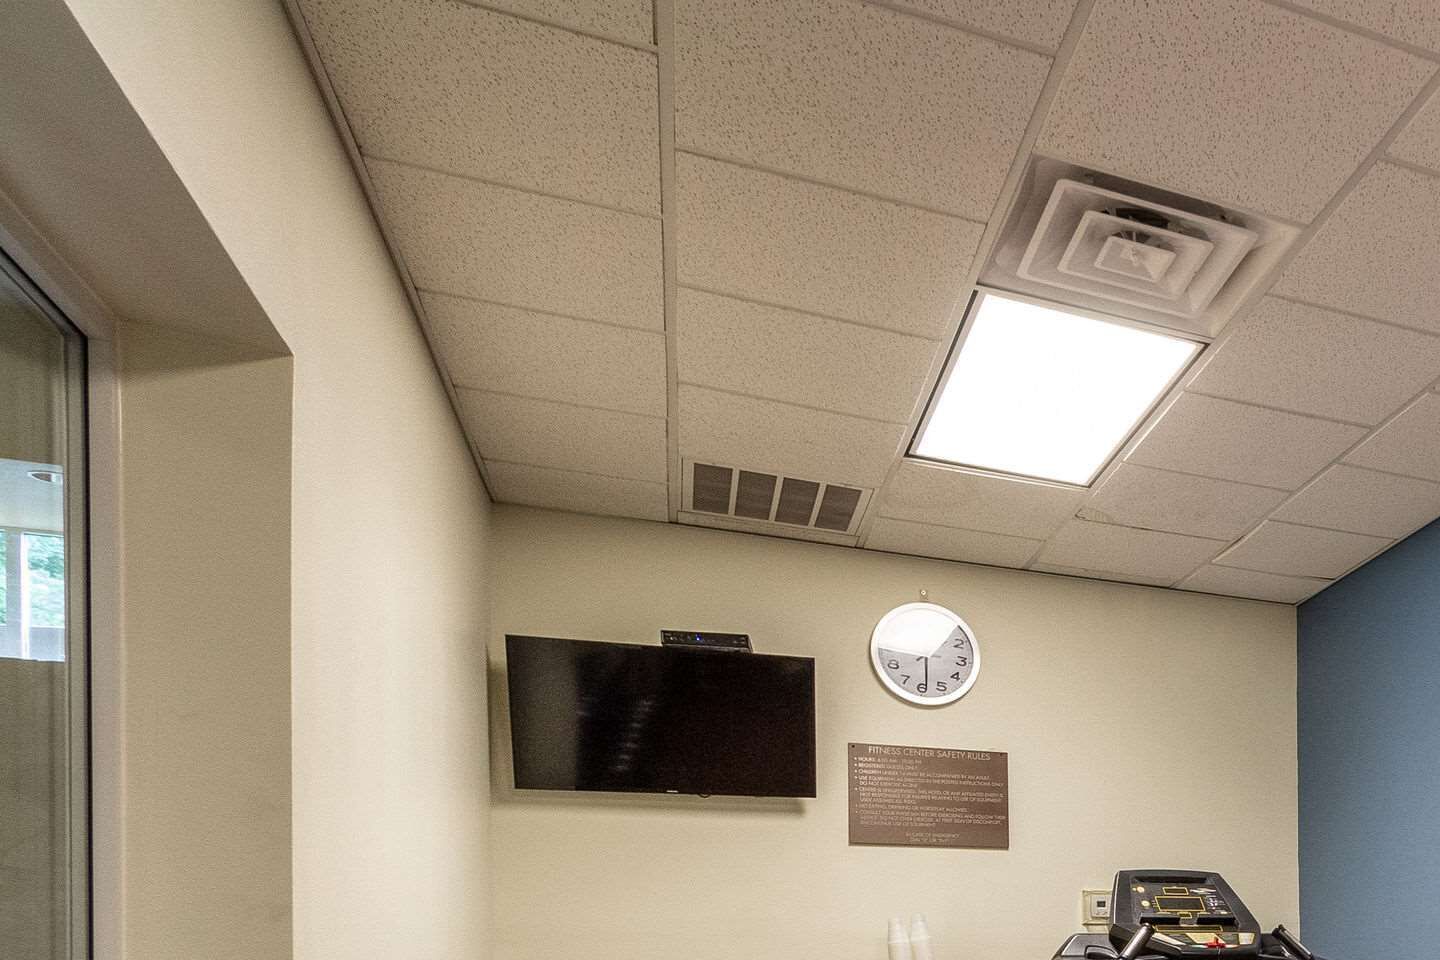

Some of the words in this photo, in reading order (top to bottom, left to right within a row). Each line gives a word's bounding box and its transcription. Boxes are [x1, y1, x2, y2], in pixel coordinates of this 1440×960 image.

[953, 639, 964, 650] 2
[955, 655, 967, 667] 3
[900, 674, 911, 685] 7
[950, 671, 961, 681] 4
[916, 683, 927, 694] 6
[936, 681, 948, 692] 5
[868, 745, 901, 756] FITNESS
[903, 747, 935, 758] CENTER
[936, 749, 966, 760] SAFETY
[967, 751, 992, 761] RULES
